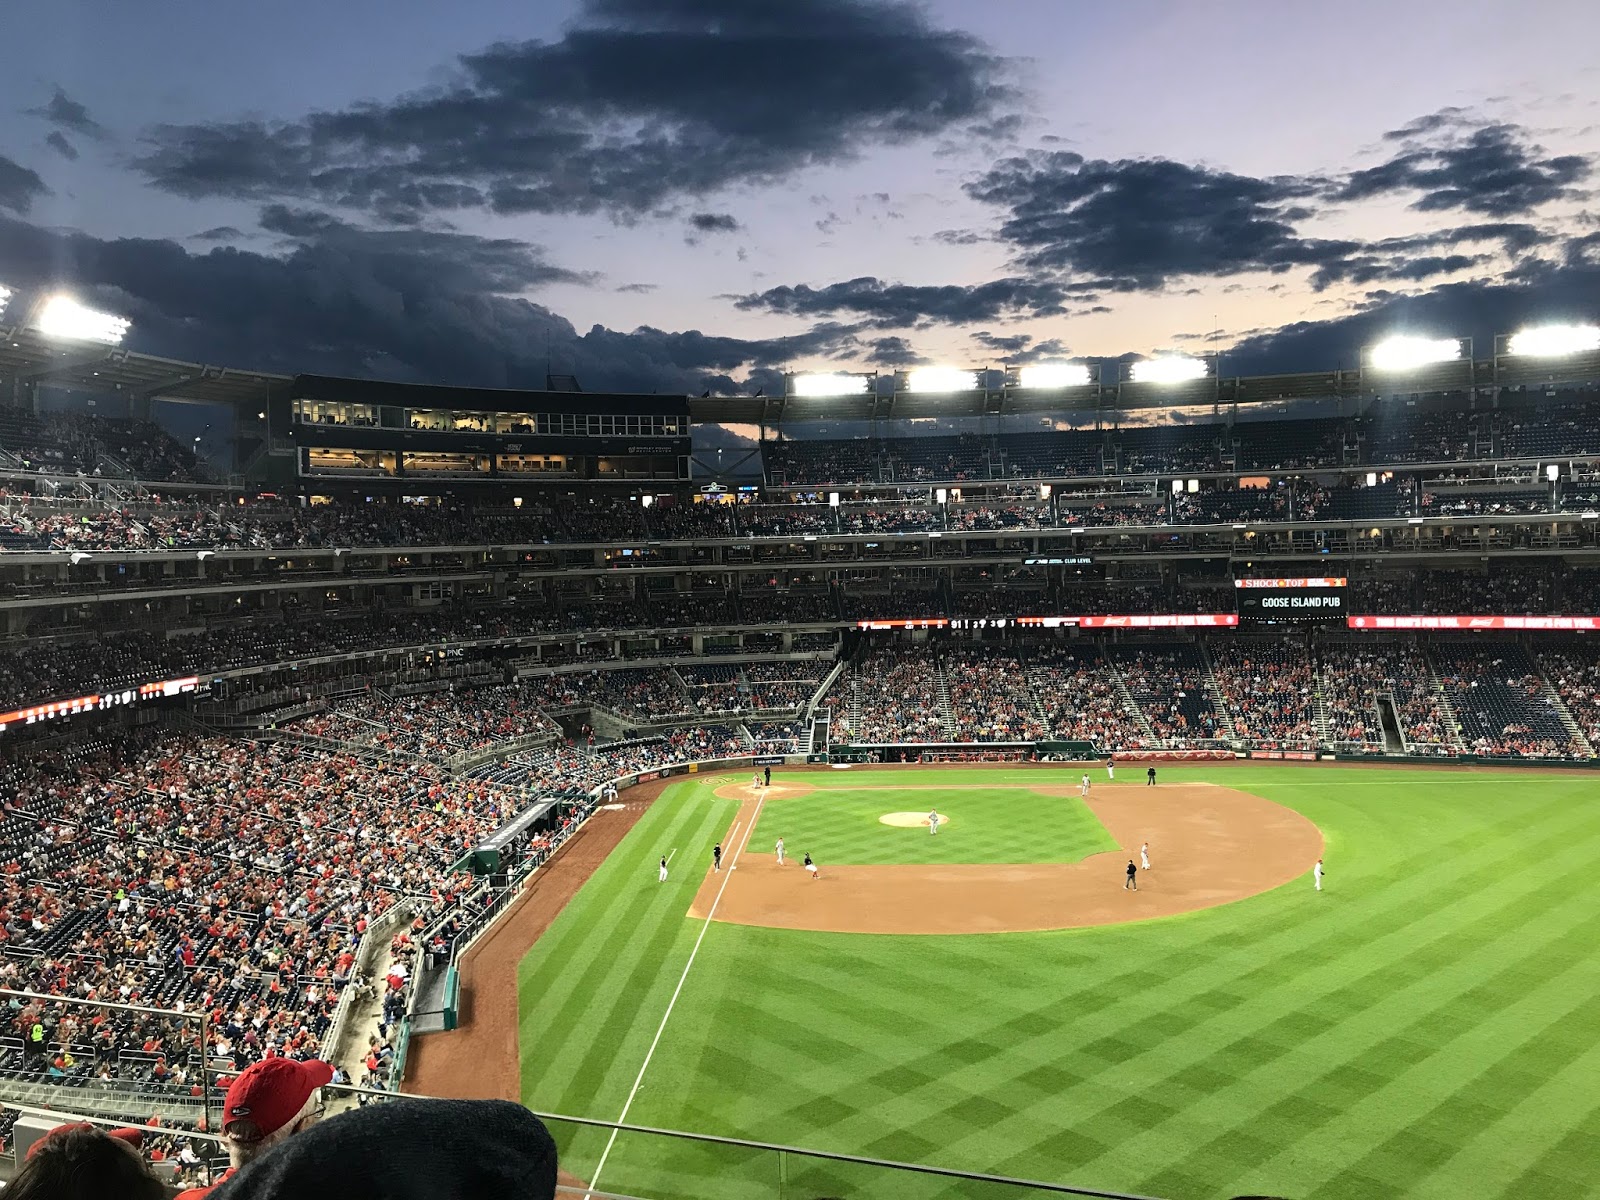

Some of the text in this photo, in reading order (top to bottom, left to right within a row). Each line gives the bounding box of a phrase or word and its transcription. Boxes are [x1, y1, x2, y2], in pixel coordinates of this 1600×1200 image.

[1245, 579, 1279, 588] SHOCK
[1284, 578, 1305, 587] TOP
[1262, 596, 1341, 608] GOOSE ISLAND PUB
[951, 620, 961, 629] 91
[447, 648, 464, 657] PNC
